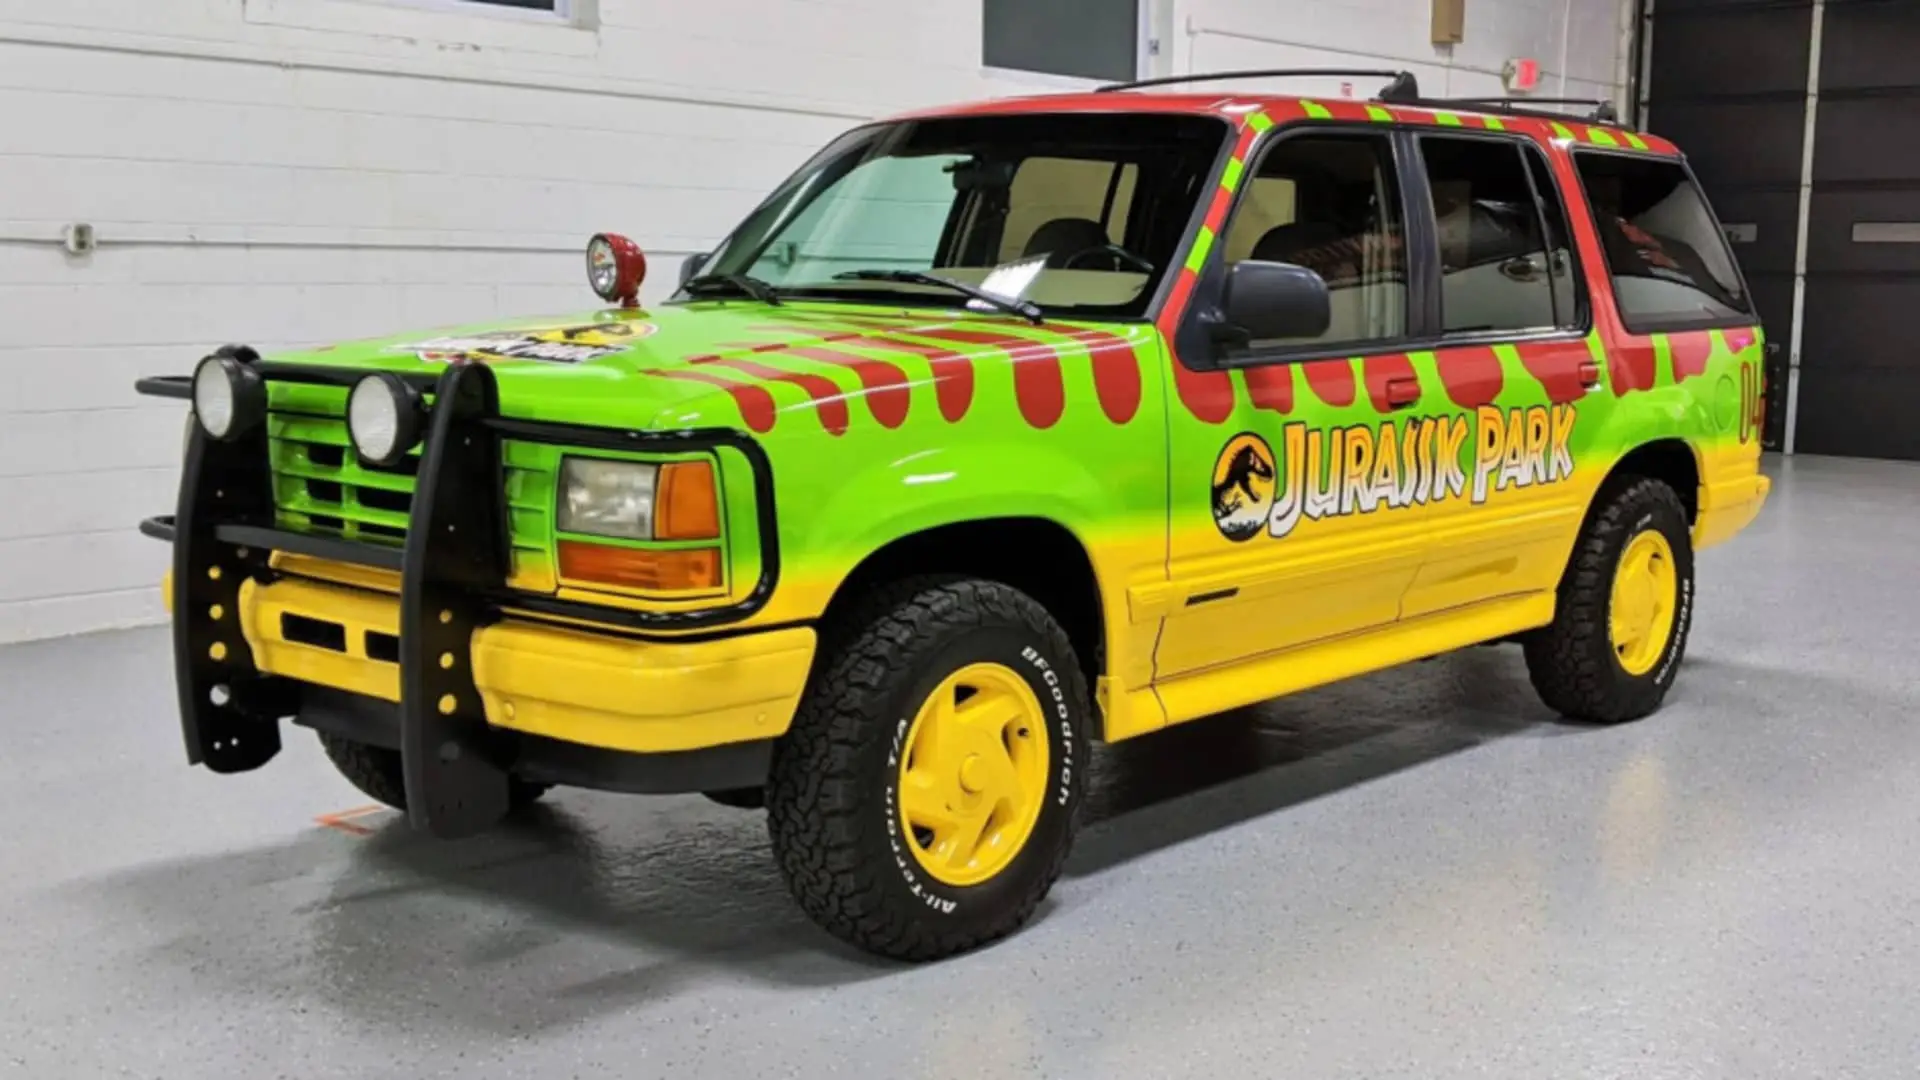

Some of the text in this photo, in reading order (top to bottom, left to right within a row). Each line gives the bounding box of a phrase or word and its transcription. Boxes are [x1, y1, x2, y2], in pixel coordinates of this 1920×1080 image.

[1268, 402, 1577, 538] JURASSIC PARK
[1020, 645, 1073, 806] BFGoodrich
